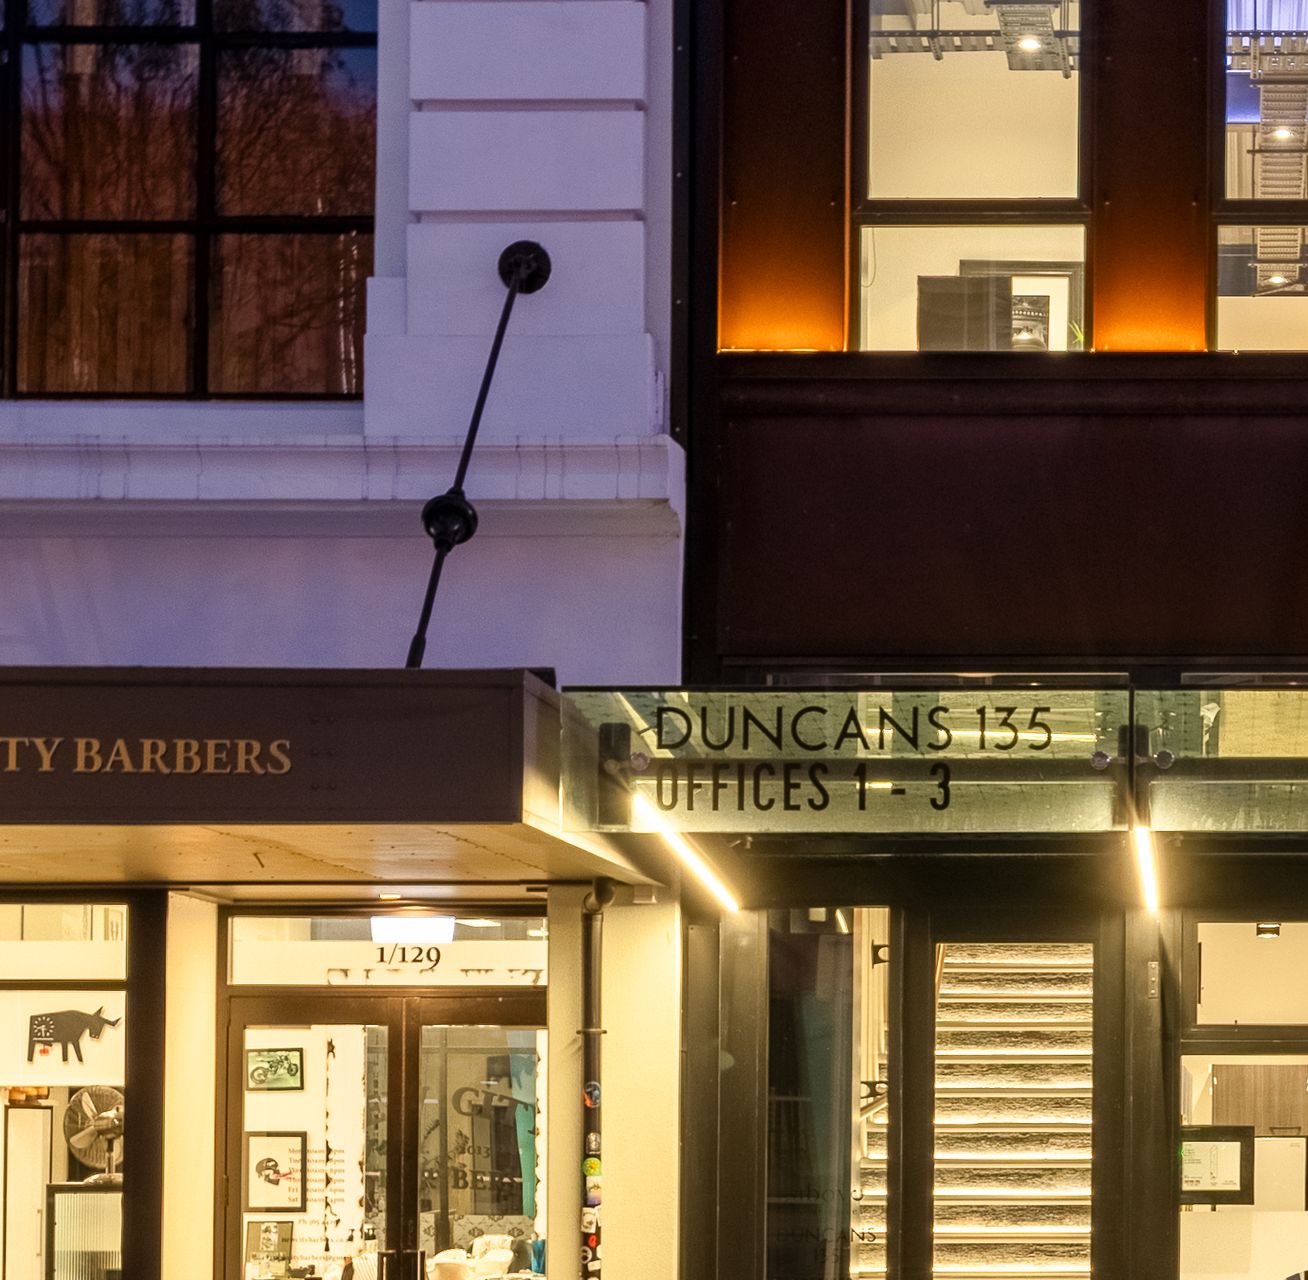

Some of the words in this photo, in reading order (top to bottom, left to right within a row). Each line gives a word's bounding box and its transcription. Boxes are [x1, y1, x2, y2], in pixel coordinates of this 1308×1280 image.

[656, 705, 953, 751] DUNCANS
[976, 705, 1052, 751] 135
[0, 737, 64, 772] TY
[73, 737, 292, 775] BARBERS
[656, 763, 830, 811] OFFICES
[854, 764, 866, 811] 1
[929, 764, 950, 811] 3
[376, 943, 441, 970] 1/129
